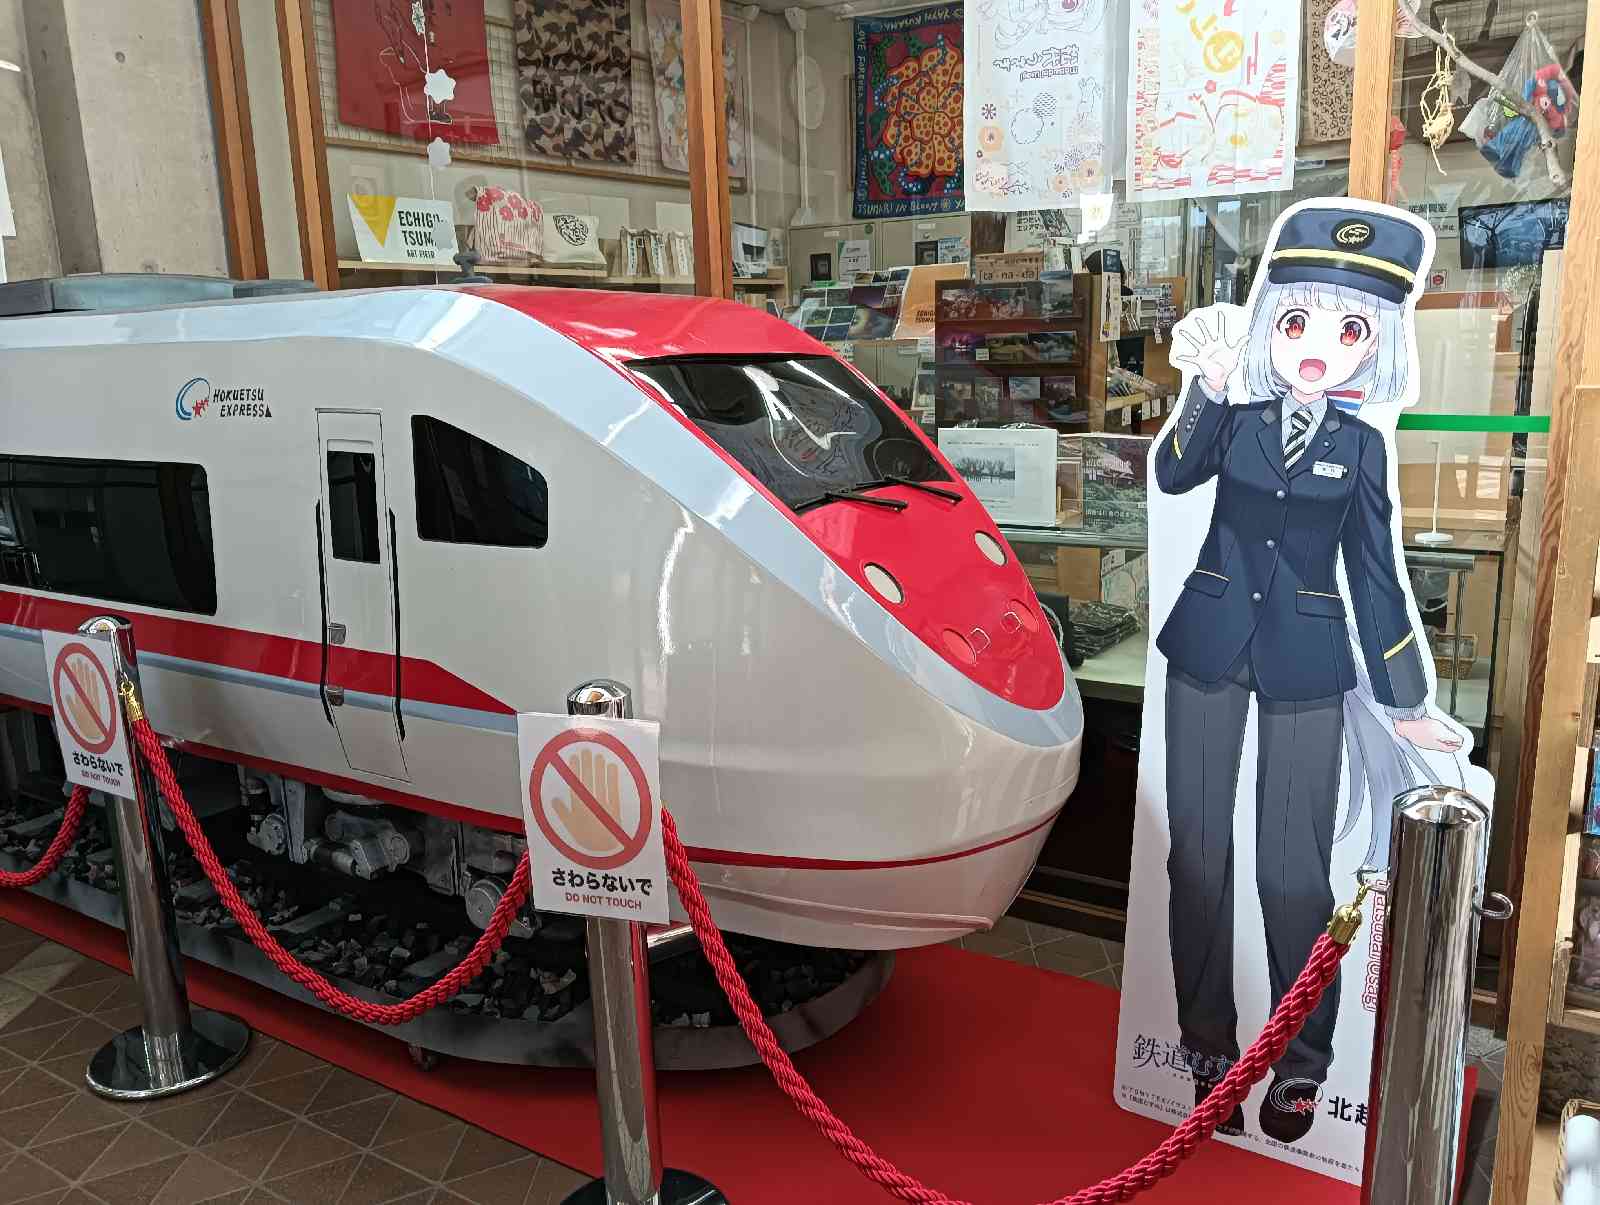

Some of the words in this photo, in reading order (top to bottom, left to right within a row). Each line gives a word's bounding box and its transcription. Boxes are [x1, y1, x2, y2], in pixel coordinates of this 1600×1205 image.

[401, 230, 438, 248] TSUM
[213, 387, 264, 403] HOKUETSU
[220, 403, 265, 418] EXPRESS
[72, 751, 124, 777] さわらないで
[551, 867, 653, 896] さわらないで
[565, 892, 580, 903] DO
[582, 895, 604, 905] NOT
[605, 896, 642, 910] TOUCH
